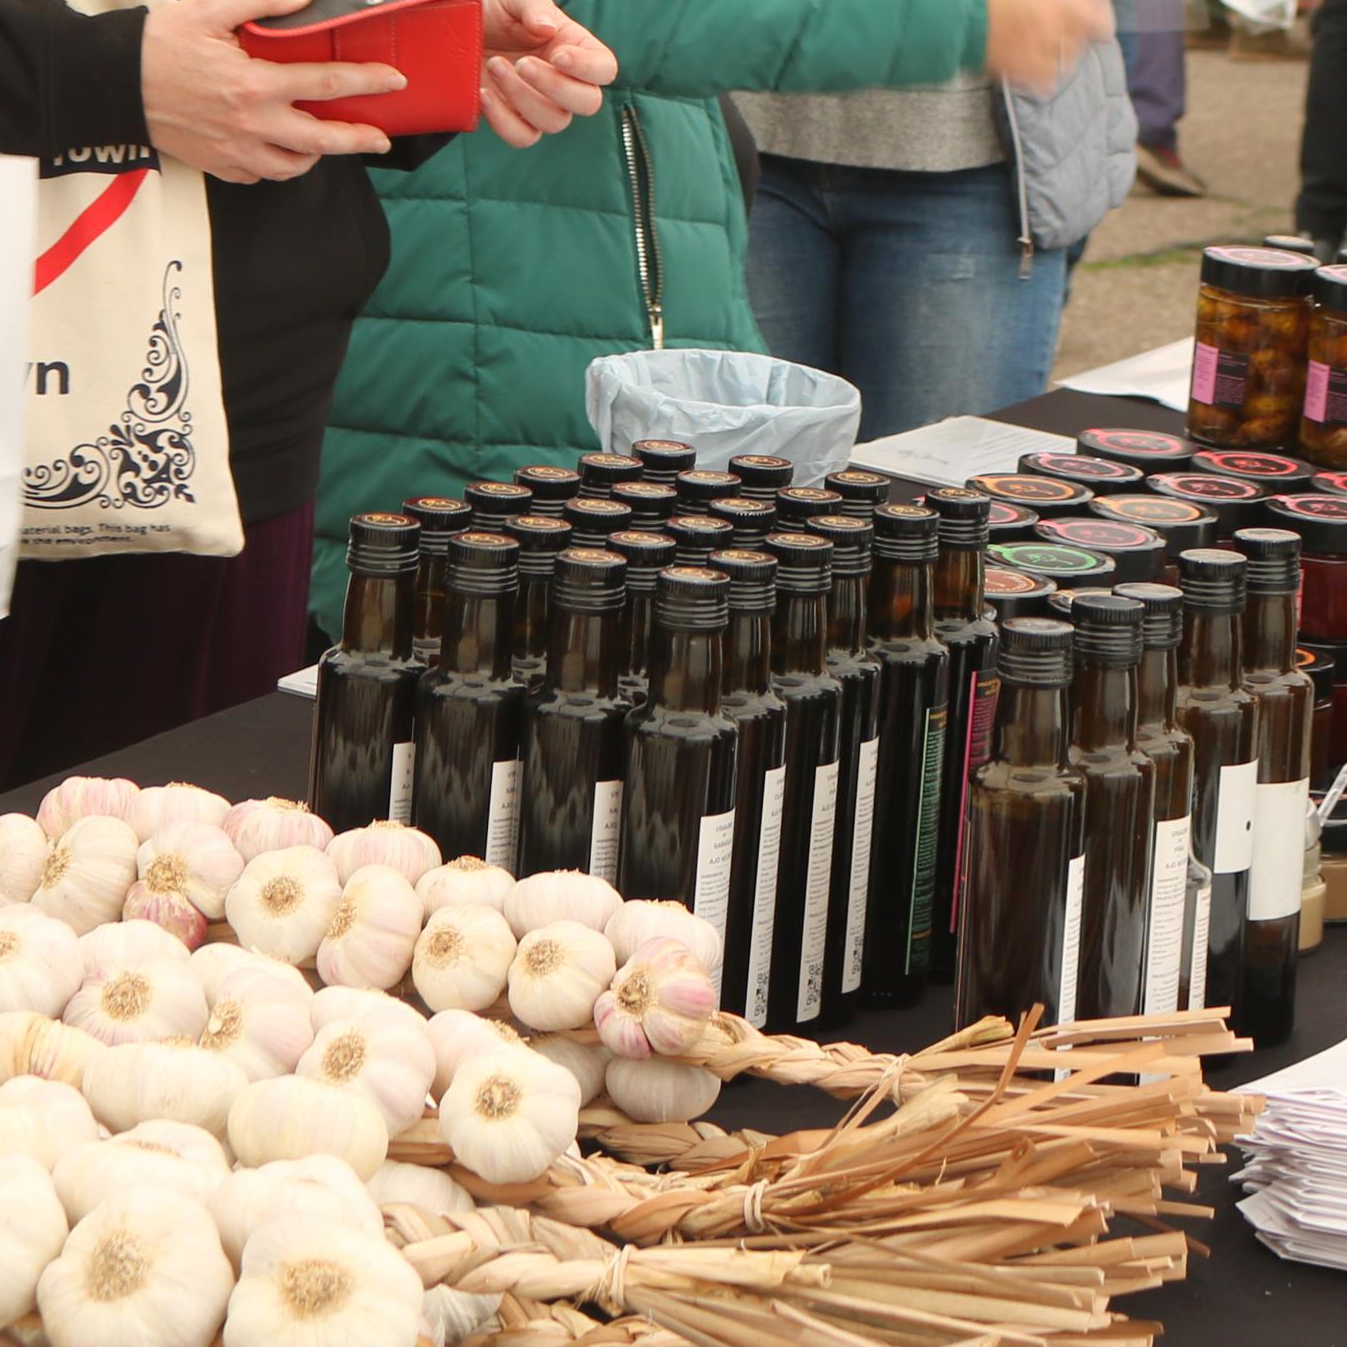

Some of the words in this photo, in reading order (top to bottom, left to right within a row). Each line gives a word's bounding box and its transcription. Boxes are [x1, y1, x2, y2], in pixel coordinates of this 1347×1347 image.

[98, 523, 122, 533] This
[125, 524, 147, 536] bag
[150, 523, 172, 533] has
